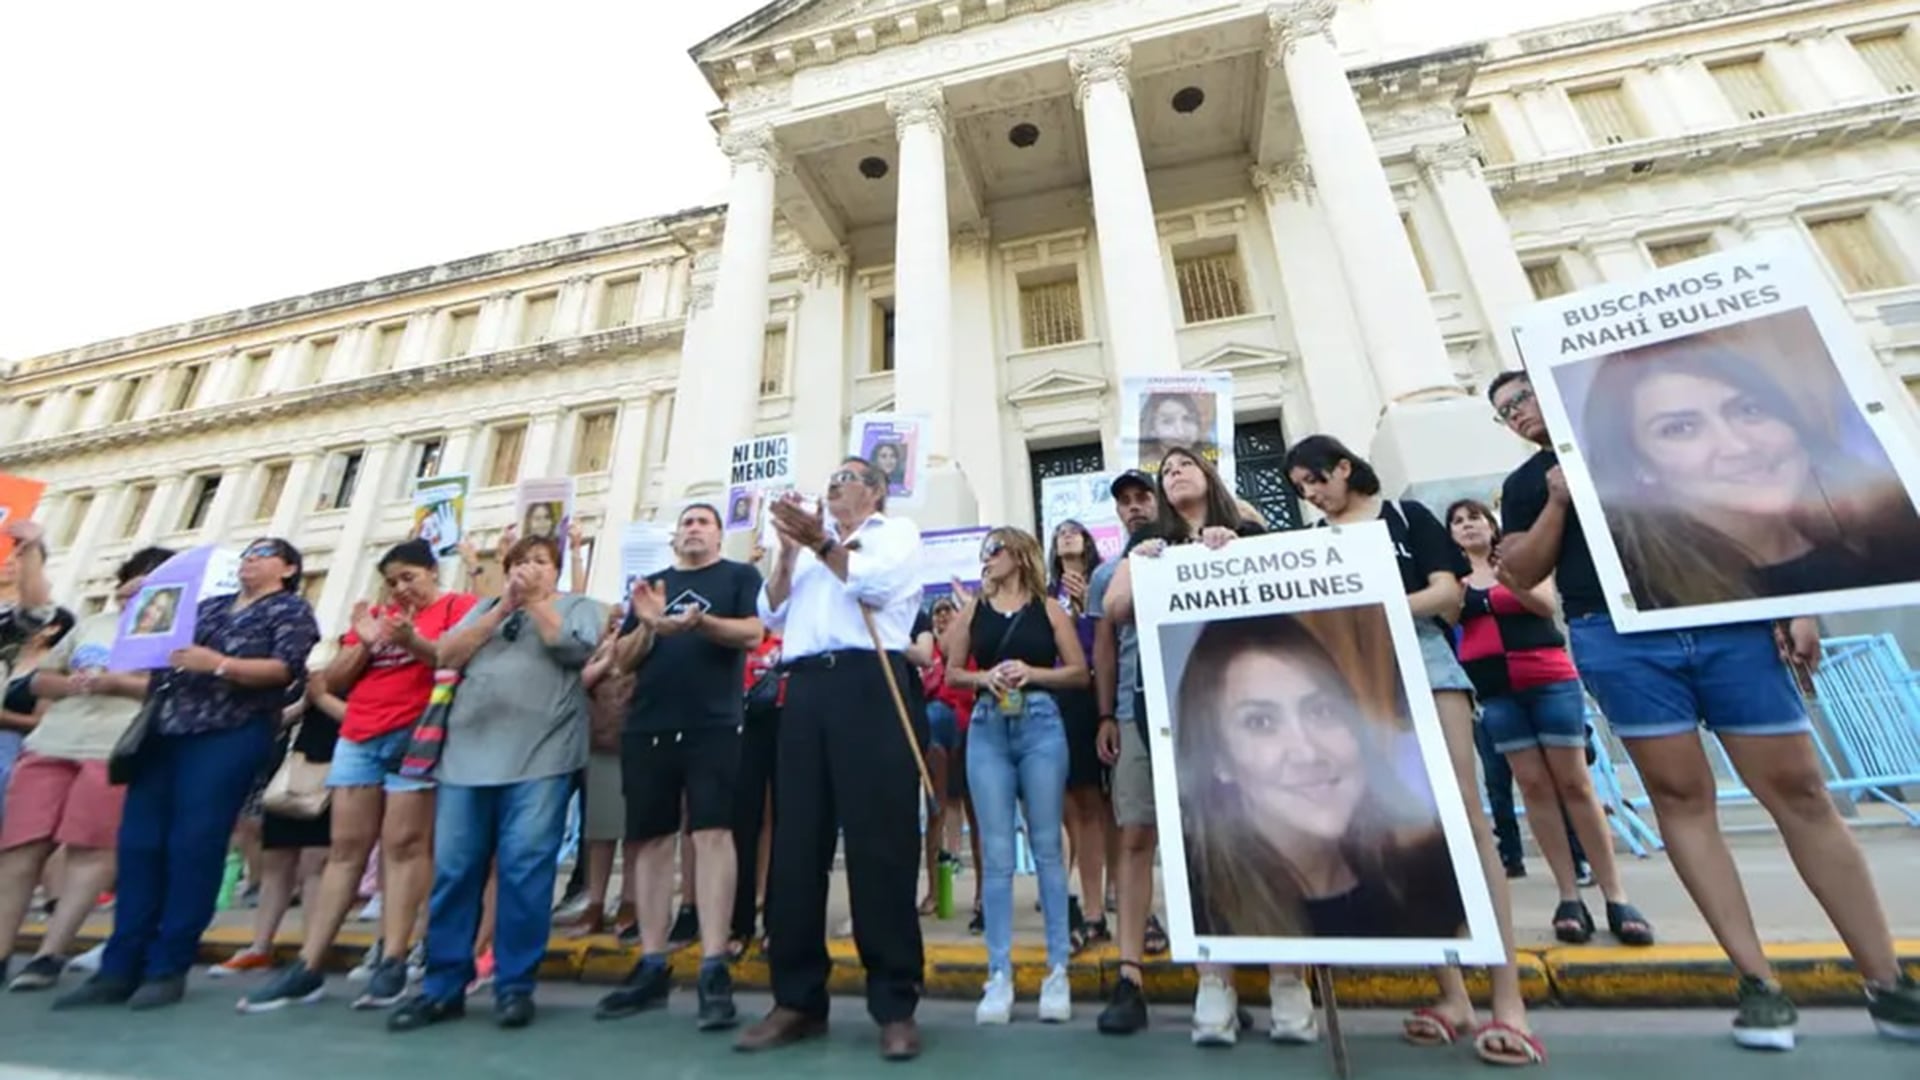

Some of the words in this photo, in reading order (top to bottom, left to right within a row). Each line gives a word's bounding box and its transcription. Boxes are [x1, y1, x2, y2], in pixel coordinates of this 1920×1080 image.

[1562, 271, 1723, 327] BUSCAMOS
[1732, 265, 1754, 284] A
[1559, 312, 1651, 354] ANAHÍ
[1658, 284, 1781, 330] BULNES
[732, 444, 750, 463] NI
[754, 438, 788, 458] UNA
[731, 459, 788, 484] MENOS
[1176, 549, 1318, 583] BUSCAMOS
[1325, 546, 1344, 566] A
[1168, 579, 1250, 612] ANAHÍ
[1258, 573, 1364, 603] BULNES
